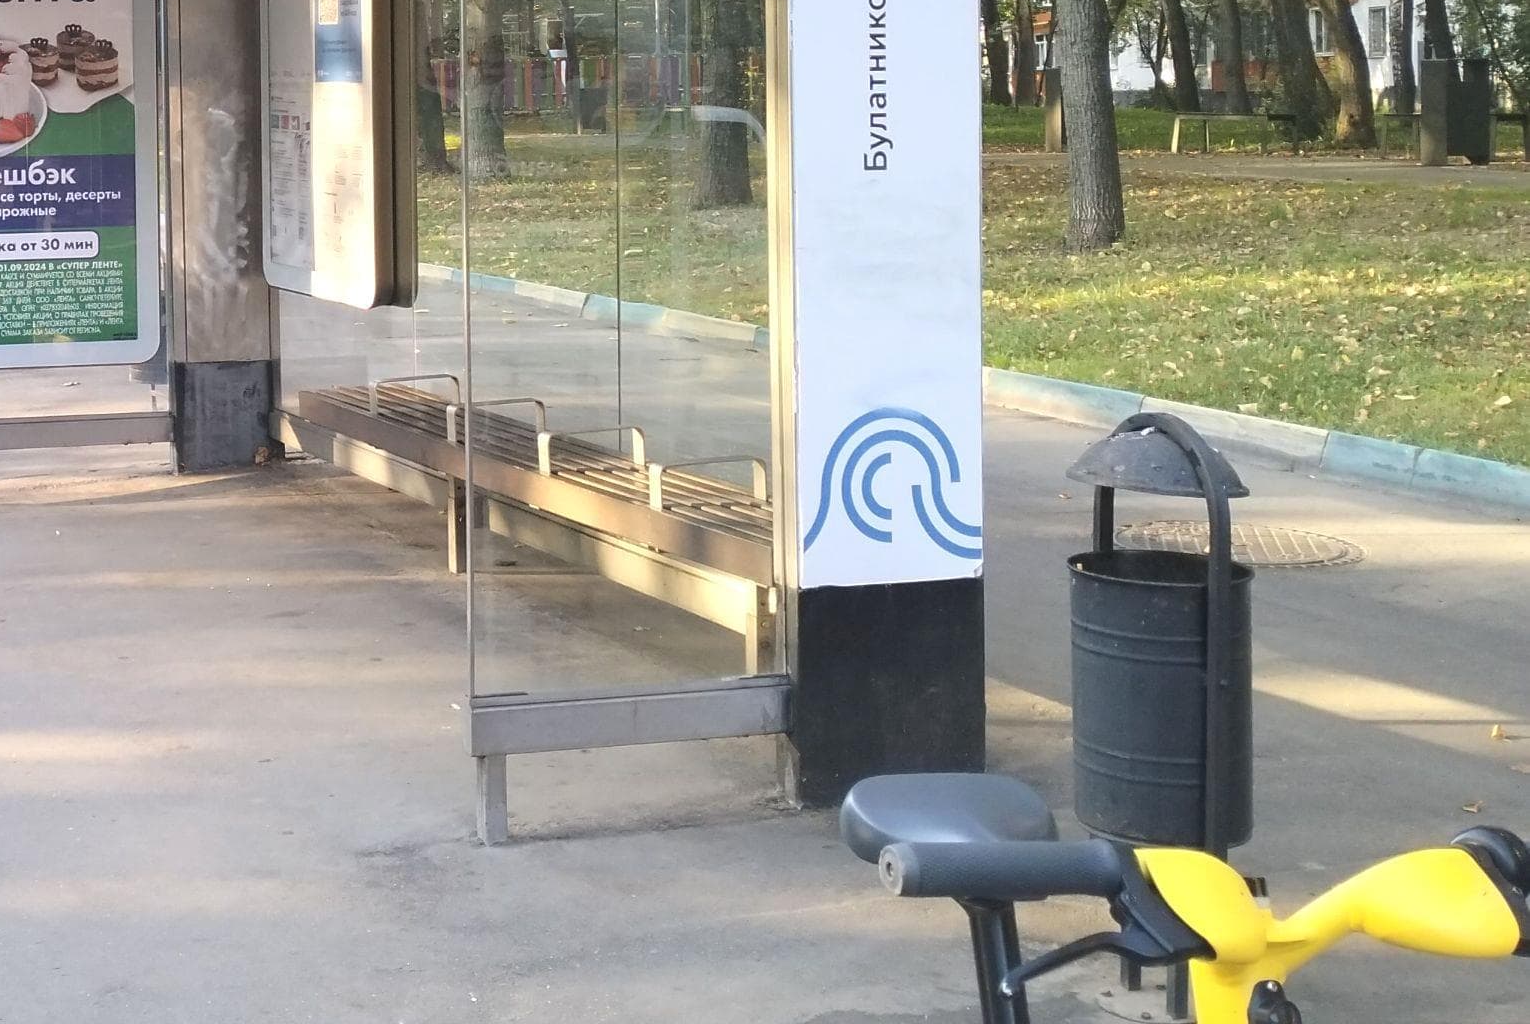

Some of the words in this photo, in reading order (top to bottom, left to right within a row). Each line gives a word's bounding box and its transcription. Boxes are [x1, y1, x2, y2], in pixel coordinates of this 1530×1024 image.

[19, 191, 61, 205] торты,
[65, 190, 121, 203] десерты
[20, 243, 37, 251] от
[41, 238, 60, 251] 30
[64, 240, 93, 251] мин
[49, 262, 54, 271] В
